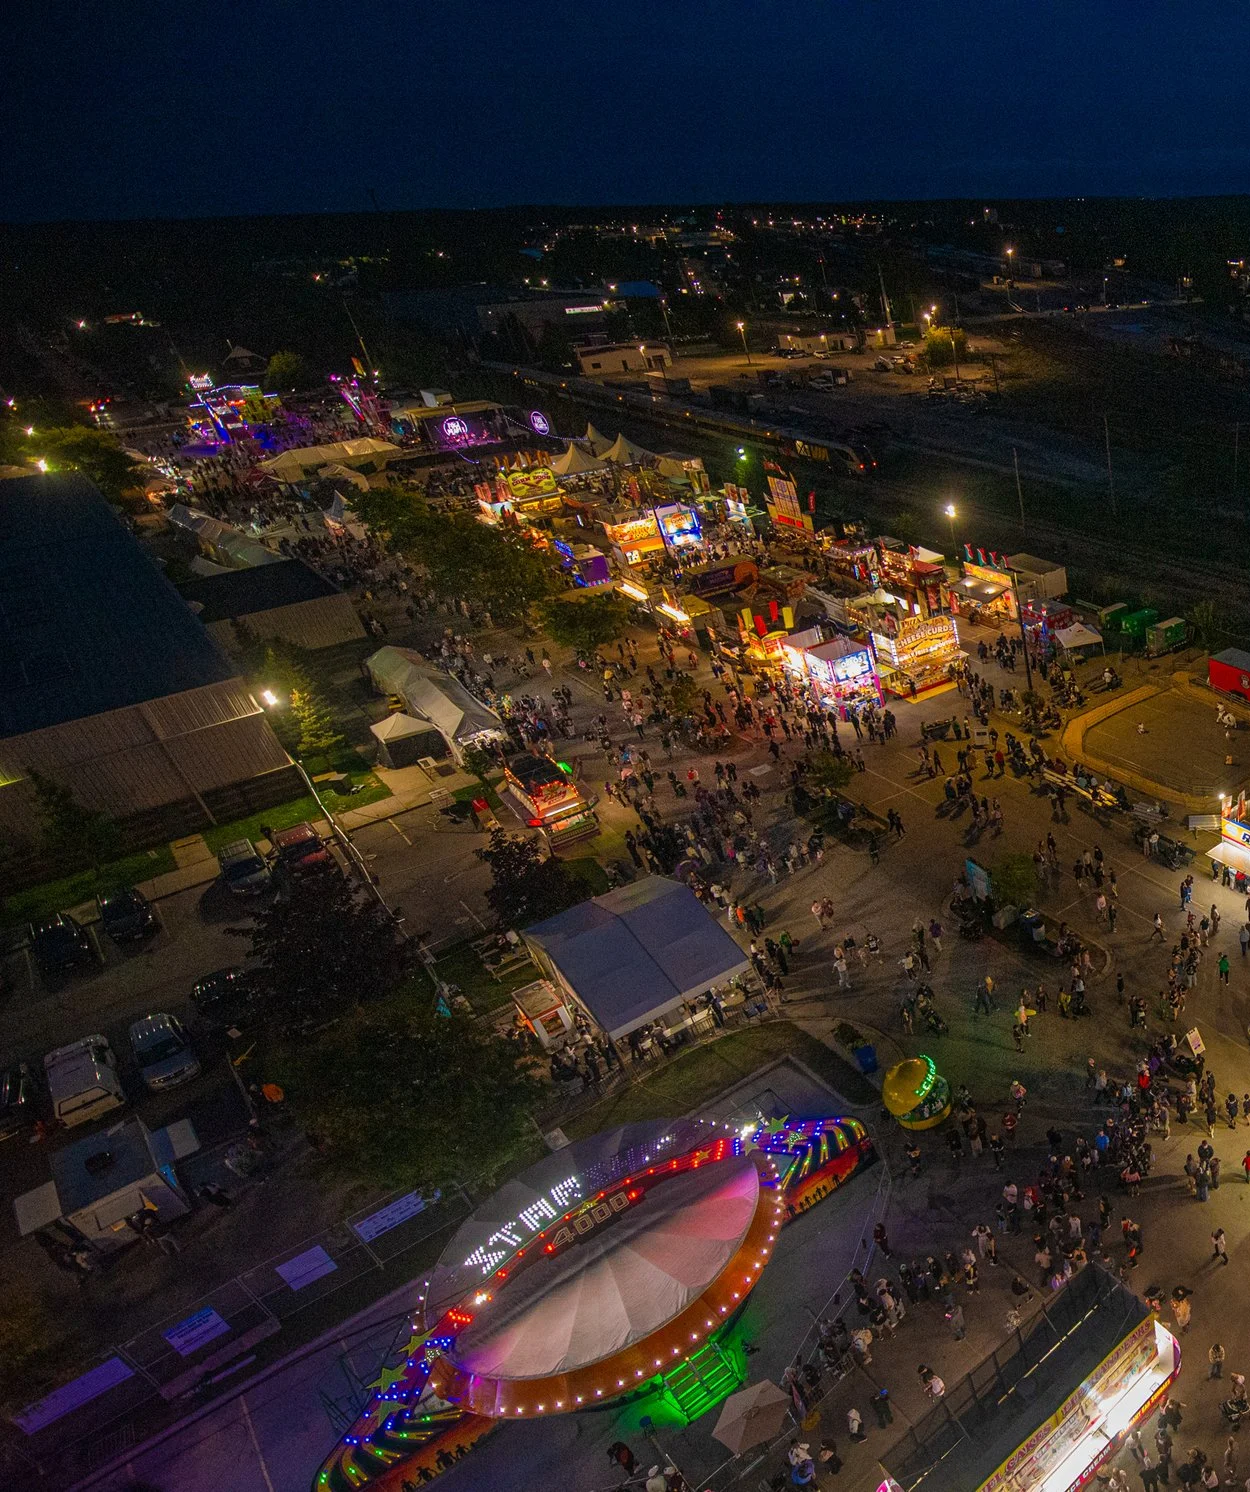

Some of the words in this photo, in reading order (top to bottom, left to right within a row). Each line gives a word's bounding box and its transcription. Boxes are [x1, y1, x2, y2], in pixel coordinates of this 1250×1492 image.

[896, 631, 926, 649] CHEESE
[927, 624, 954, 636] CURDS
[552, 1191, 630, 1246] 4000
[1082, 1445, 1112, 1479] CREAM
